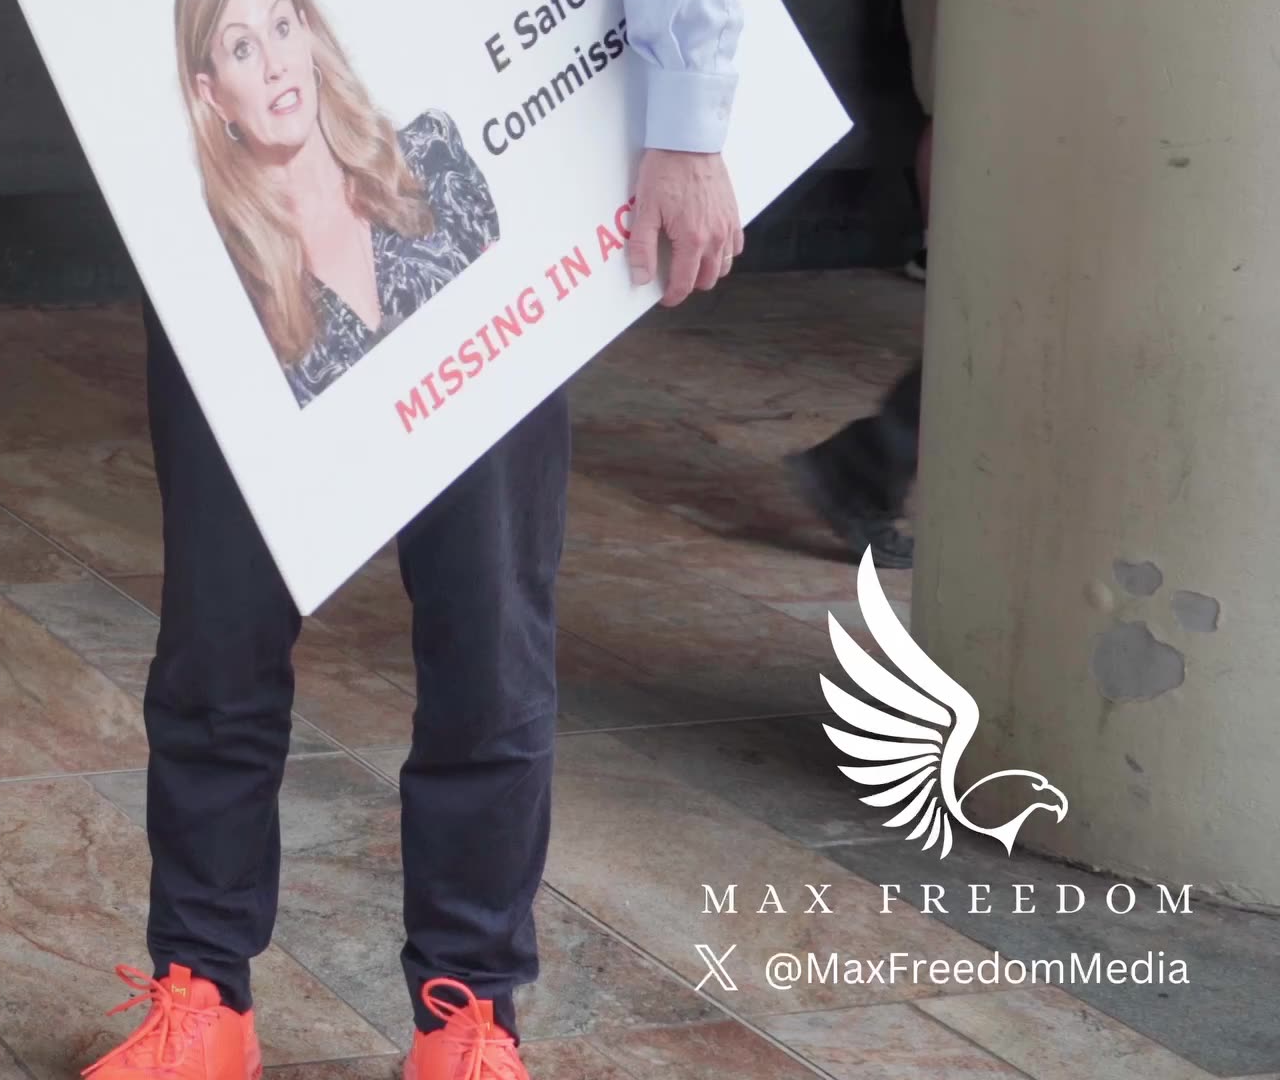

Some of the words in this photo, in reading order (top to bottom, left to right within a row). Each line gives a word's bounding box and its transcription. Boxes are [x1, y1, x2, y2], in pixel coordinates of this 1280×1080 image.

[485, 32, 511, 73] E
[395, 287, 544, 433] MISSING
[545, 246, 592, 300] IN
[596, 195, 636, 261] AC
